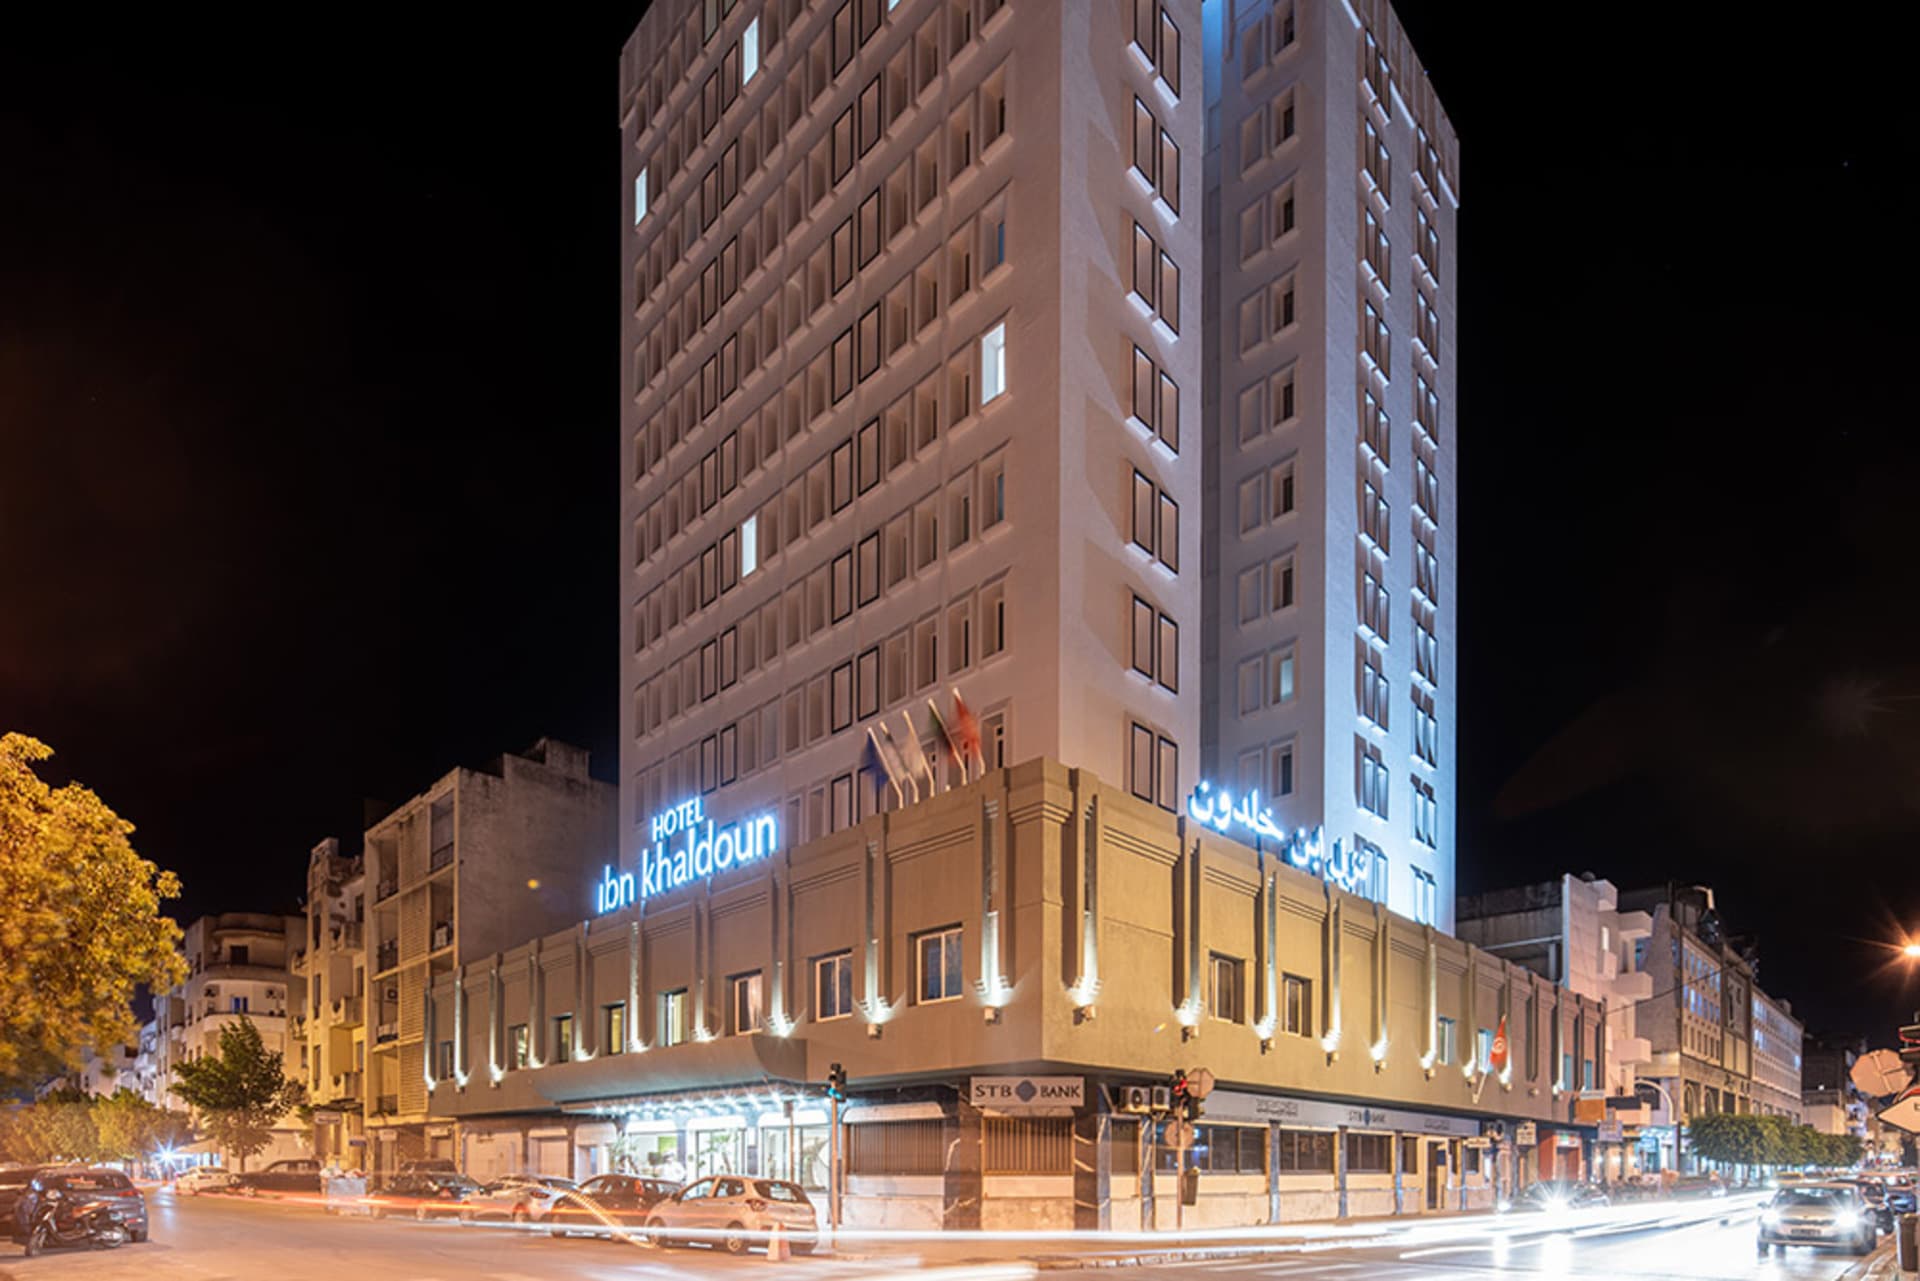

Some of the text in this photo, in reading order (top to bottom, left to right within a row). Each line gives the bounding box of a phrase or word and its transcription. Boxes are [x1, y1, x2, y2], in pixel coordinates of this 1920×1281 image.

[652, 796, 704, 842] HOTEL
[1190, 780, 1285, 841] خلدون
[640, 815, 776, 897] khaldoun
[1291, 825, 1324, 871] ابن
[974, 1083, 1081, 1098] STB BANK
